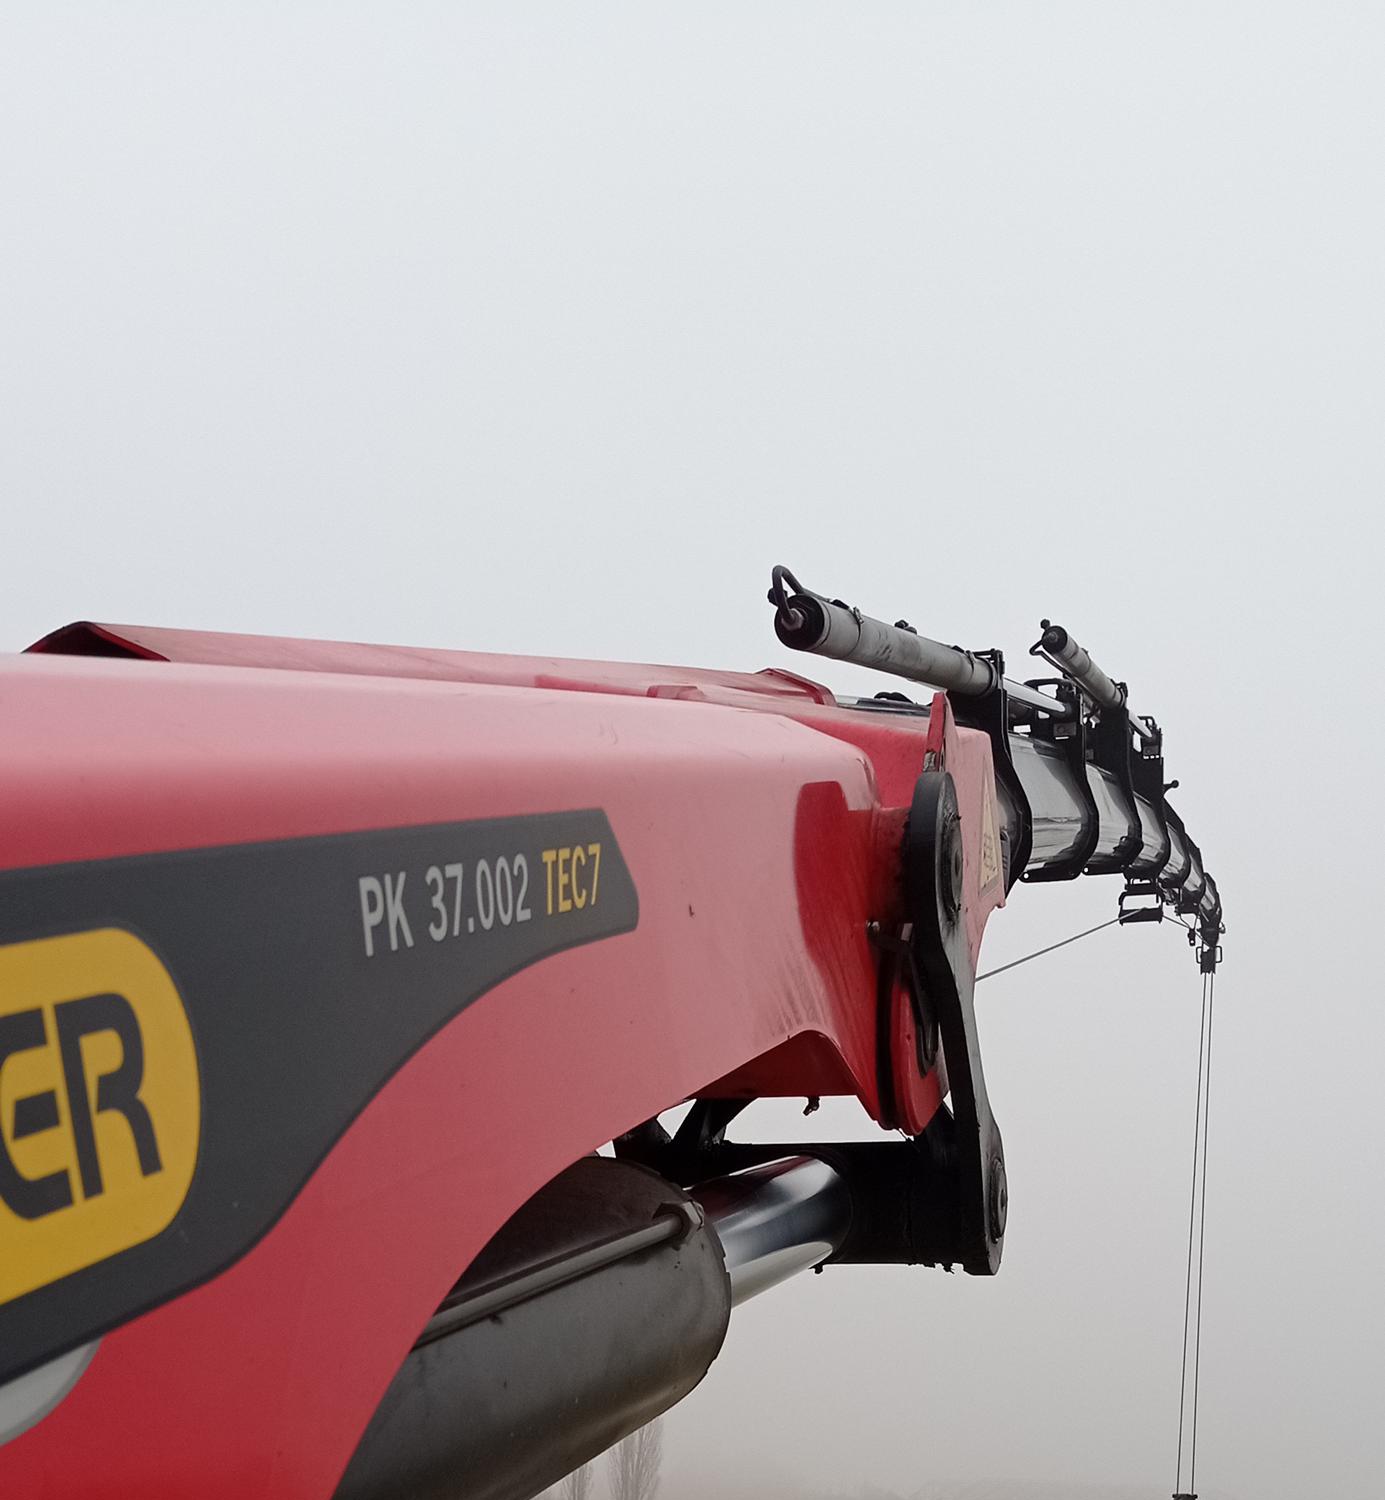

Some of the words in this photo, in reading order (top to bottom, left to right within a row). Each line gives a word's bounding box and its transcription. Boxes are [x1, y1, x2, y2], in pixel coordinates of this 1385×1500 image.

[359, 871, 414, 957] PK
[425, 853, 532, 942] 37.002
[542, 843, 601, 915] TEC7
